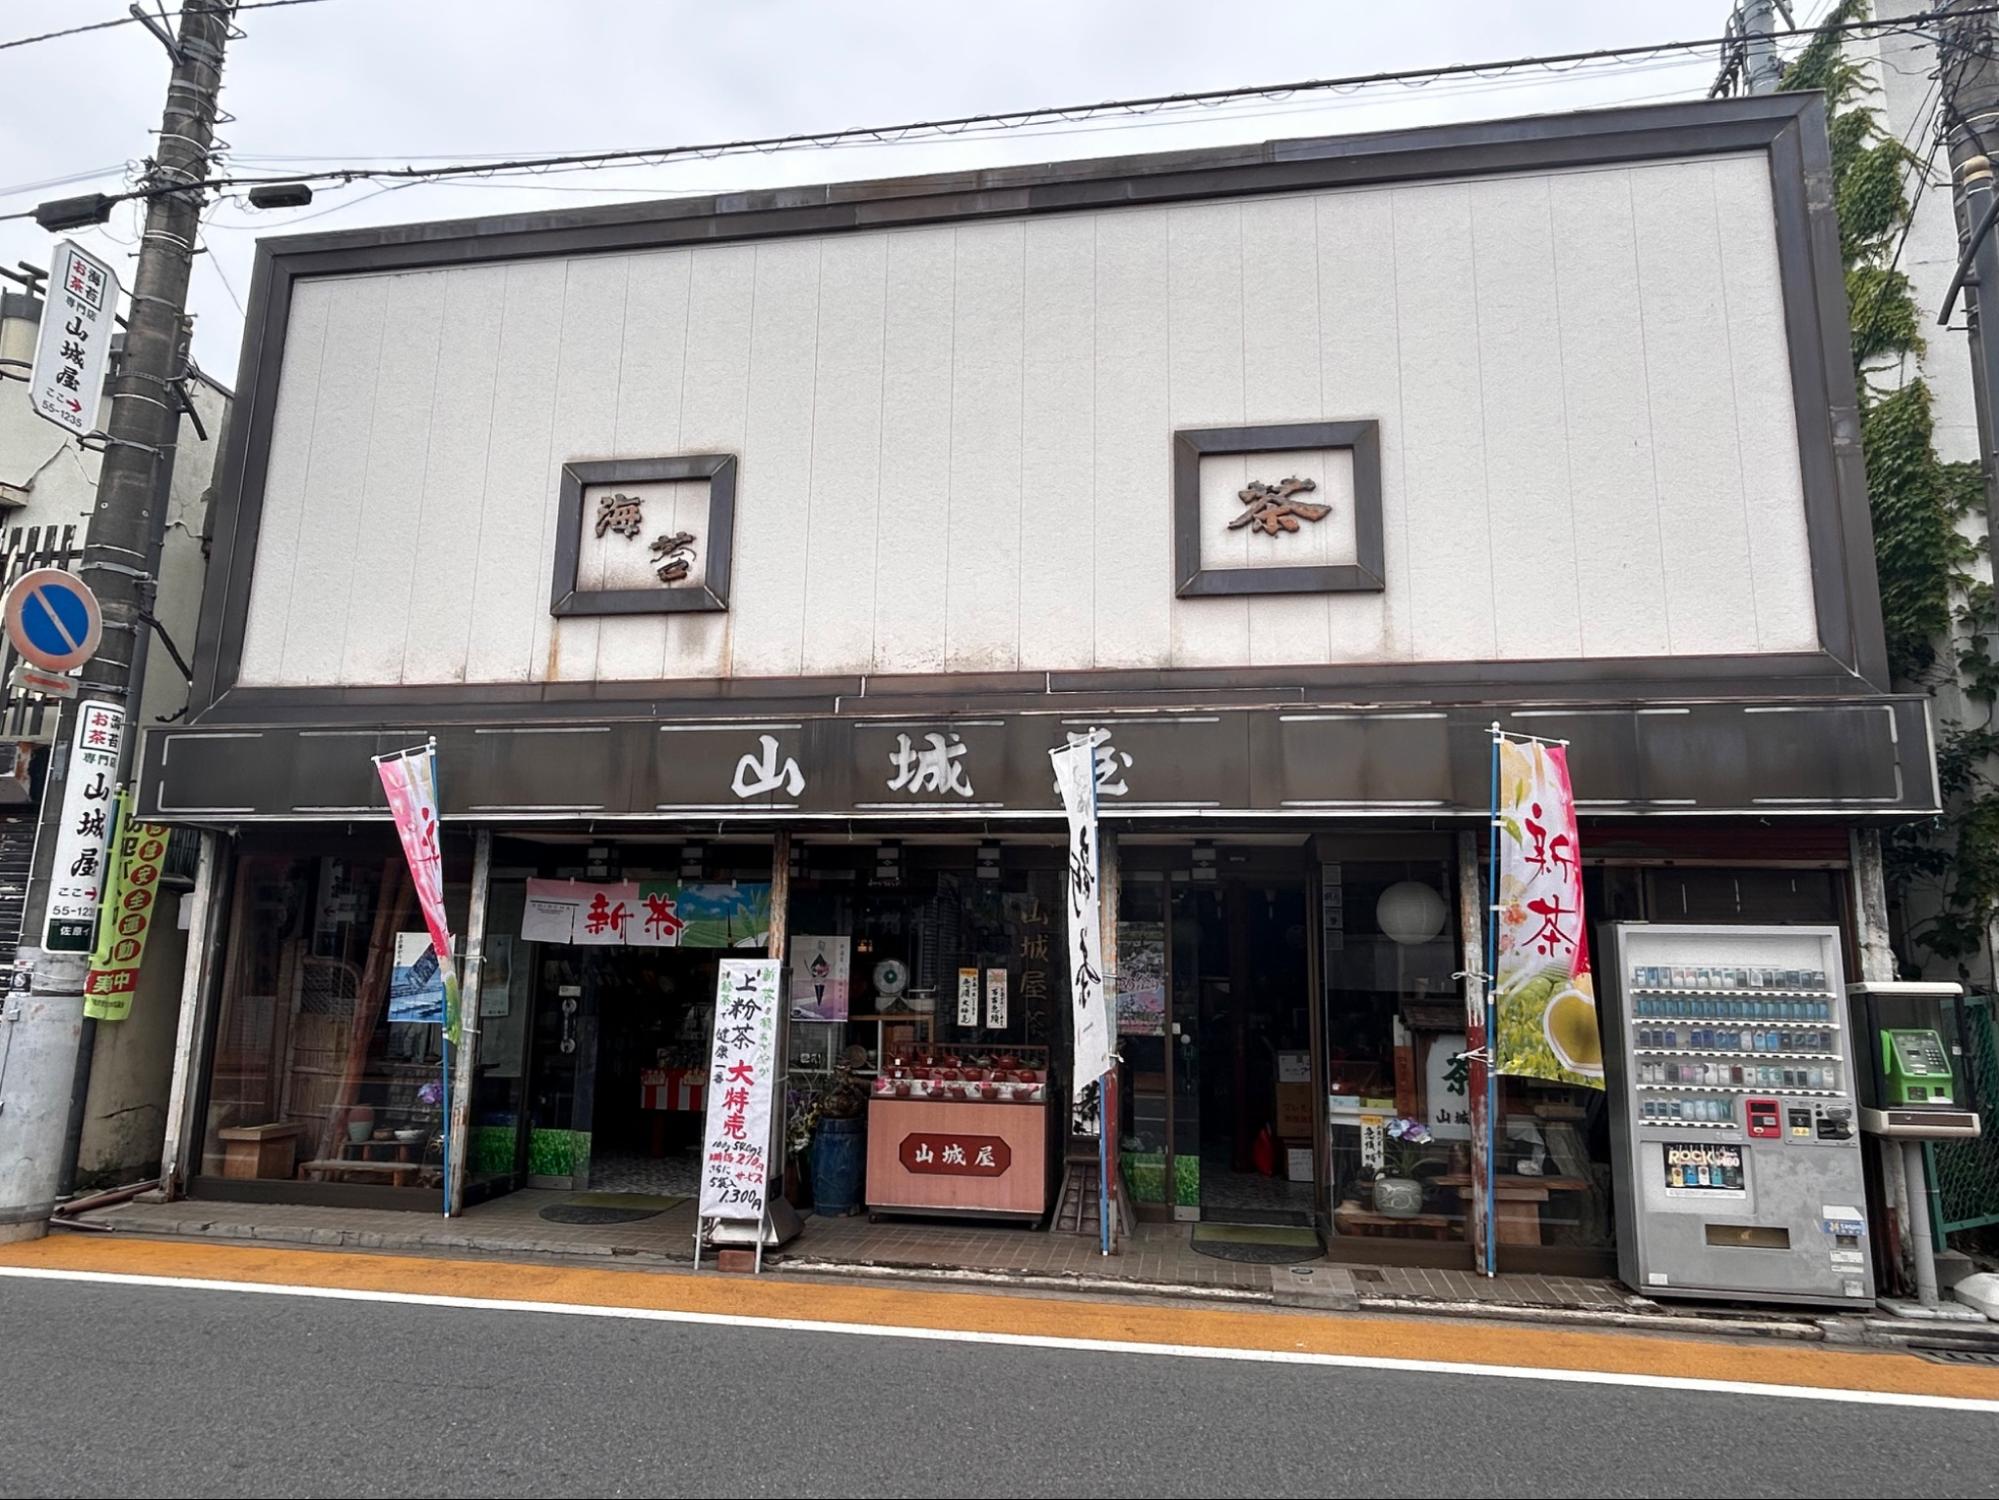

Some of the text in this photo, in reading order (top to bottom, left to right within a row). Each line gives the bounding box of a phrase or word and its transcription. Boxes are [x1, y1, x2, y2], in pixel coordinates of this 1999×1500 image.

[69, 260, 87, 293] お茶
[65, 295, 98, 322] 専門店
[56, 316, 89, 392] 山城屋
[42, 400, 83, 428] 55-1235
[46, 387, 65, 402] ここ
[1227, 475, 1332, 539] 茶
[88, 712, 109, 745] お茶
[70, 772, 109, 877] 山城屋
[58, 887, 82, 897] ここ
[1521, 803, 1578, 957] 新茶
[585, 893, 683, 940] 新茶
[729, 973, 762, 1050] 上粉茶
[721, 1059, 755, 1140] 大特売
[915, 1143, 996, 1167] 山城屋
